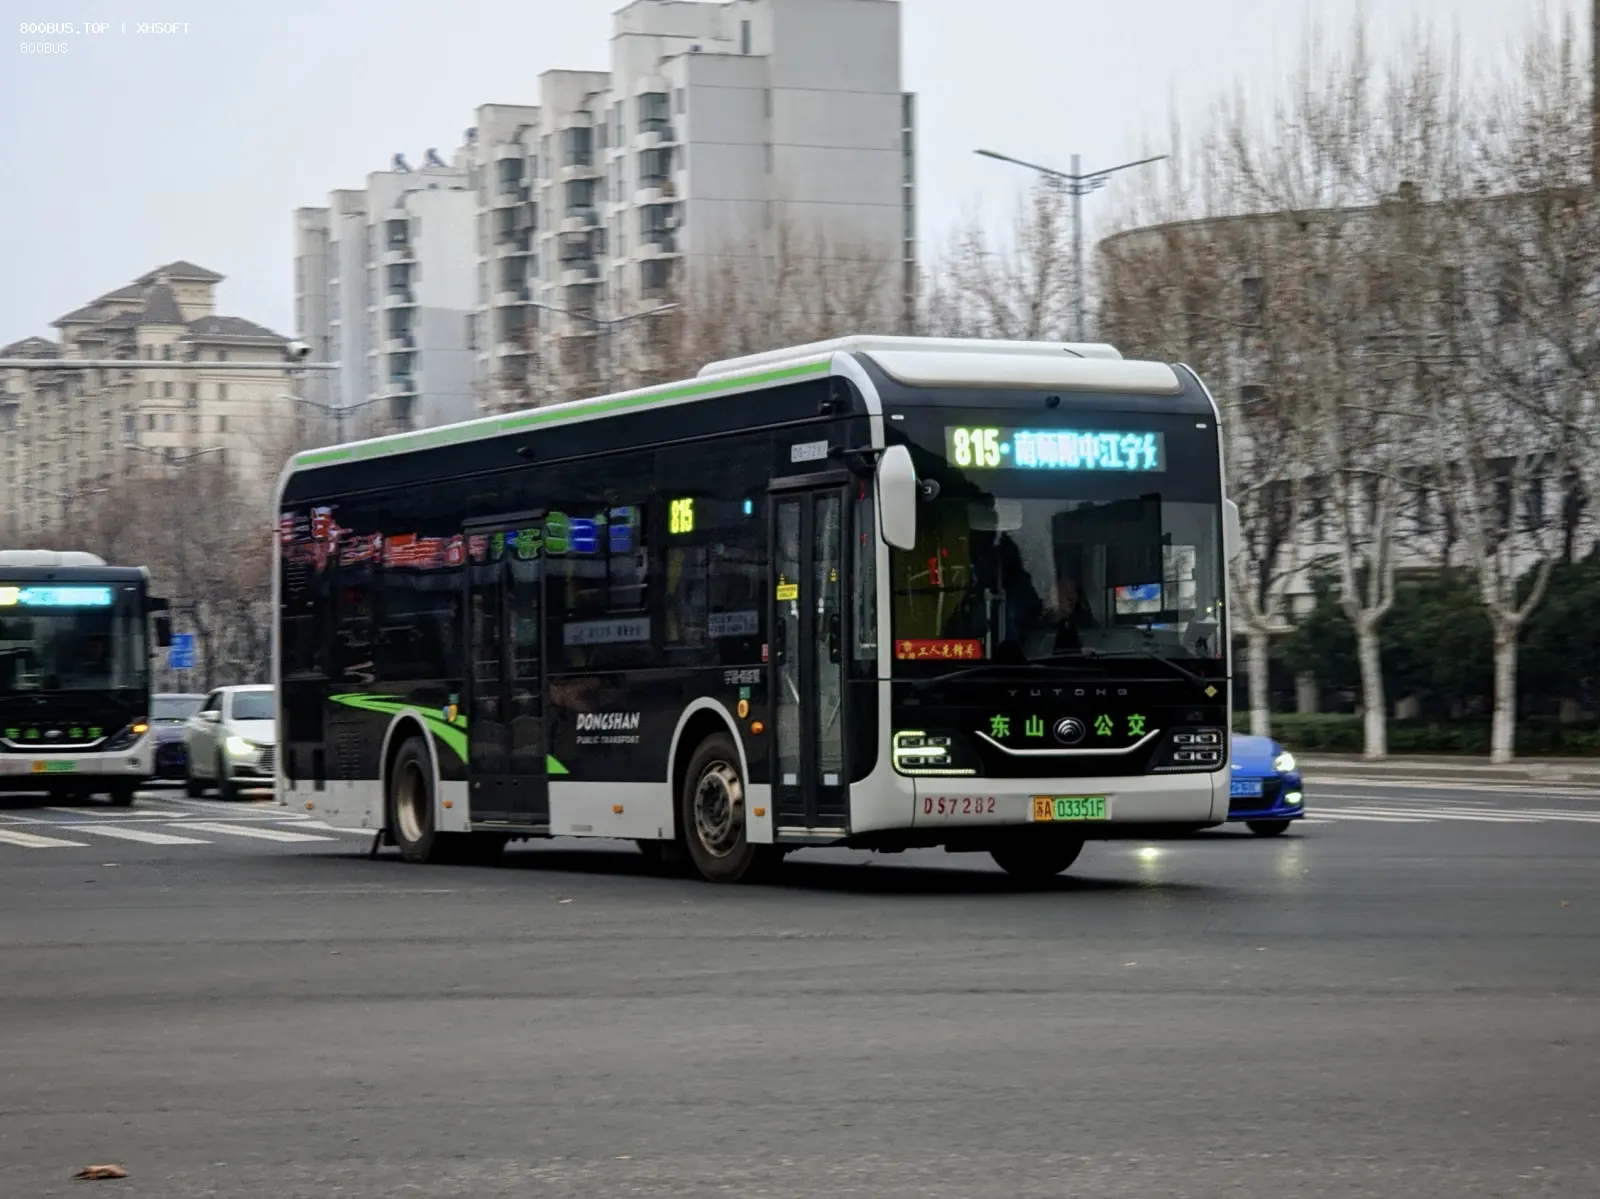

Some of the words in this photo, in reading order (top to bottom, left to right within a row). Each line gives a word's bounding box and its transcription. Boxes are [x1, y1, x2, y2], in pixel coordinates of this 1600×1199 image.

[953, 427, 1000, 466] 815
[669, 498, 694, 534] 815
[1007, 688, 1128, 697] YUTONG
[576, 711, 640, 731] DONGSHAN
[923, 796, 997, 815] DS7282
